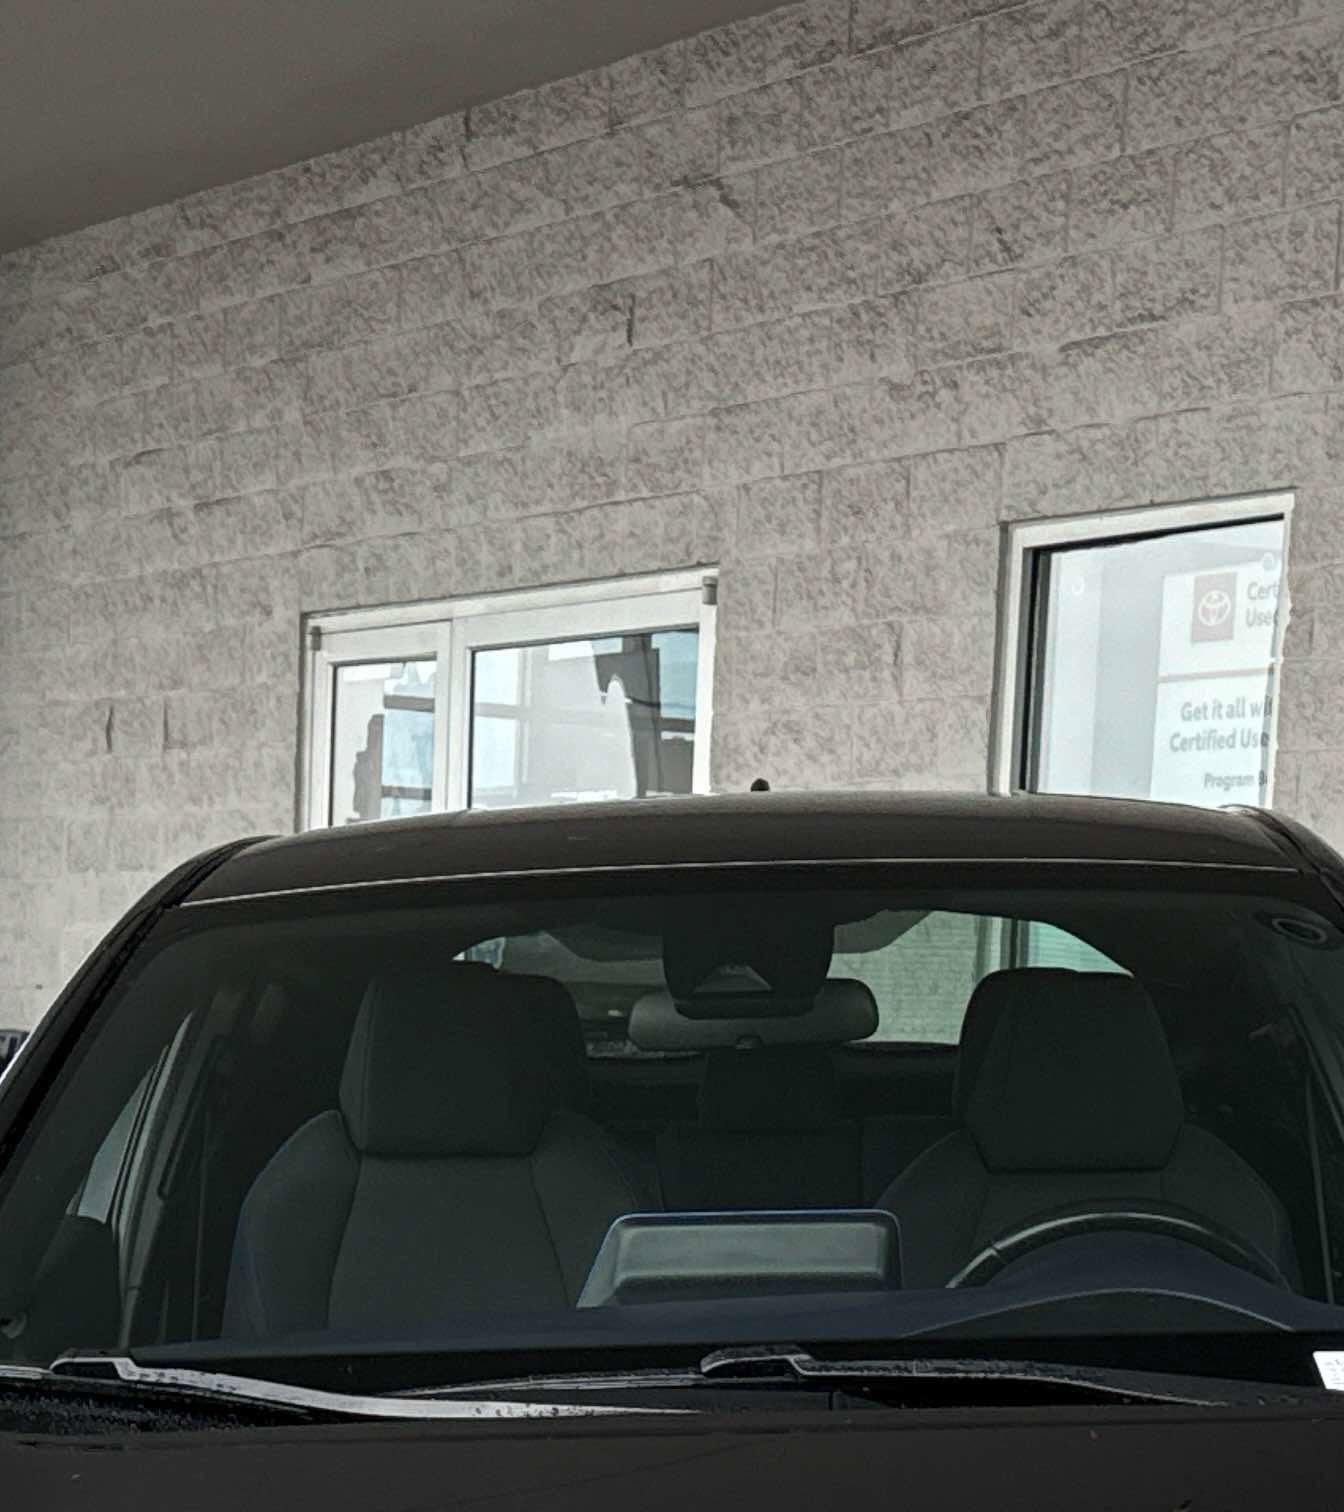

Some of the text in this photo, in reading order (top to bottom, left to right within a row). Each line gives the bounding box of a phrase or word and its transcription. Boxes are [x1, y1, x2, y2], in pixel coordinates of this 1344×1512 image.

[1180, 701, 1208, 722] Get
[1212, 698, 1223, 720] it
[1226, 696, 1246, 719] all
[1169, 728, 1237, 752] Certified
[1203, 772, 1255, 791] Program
